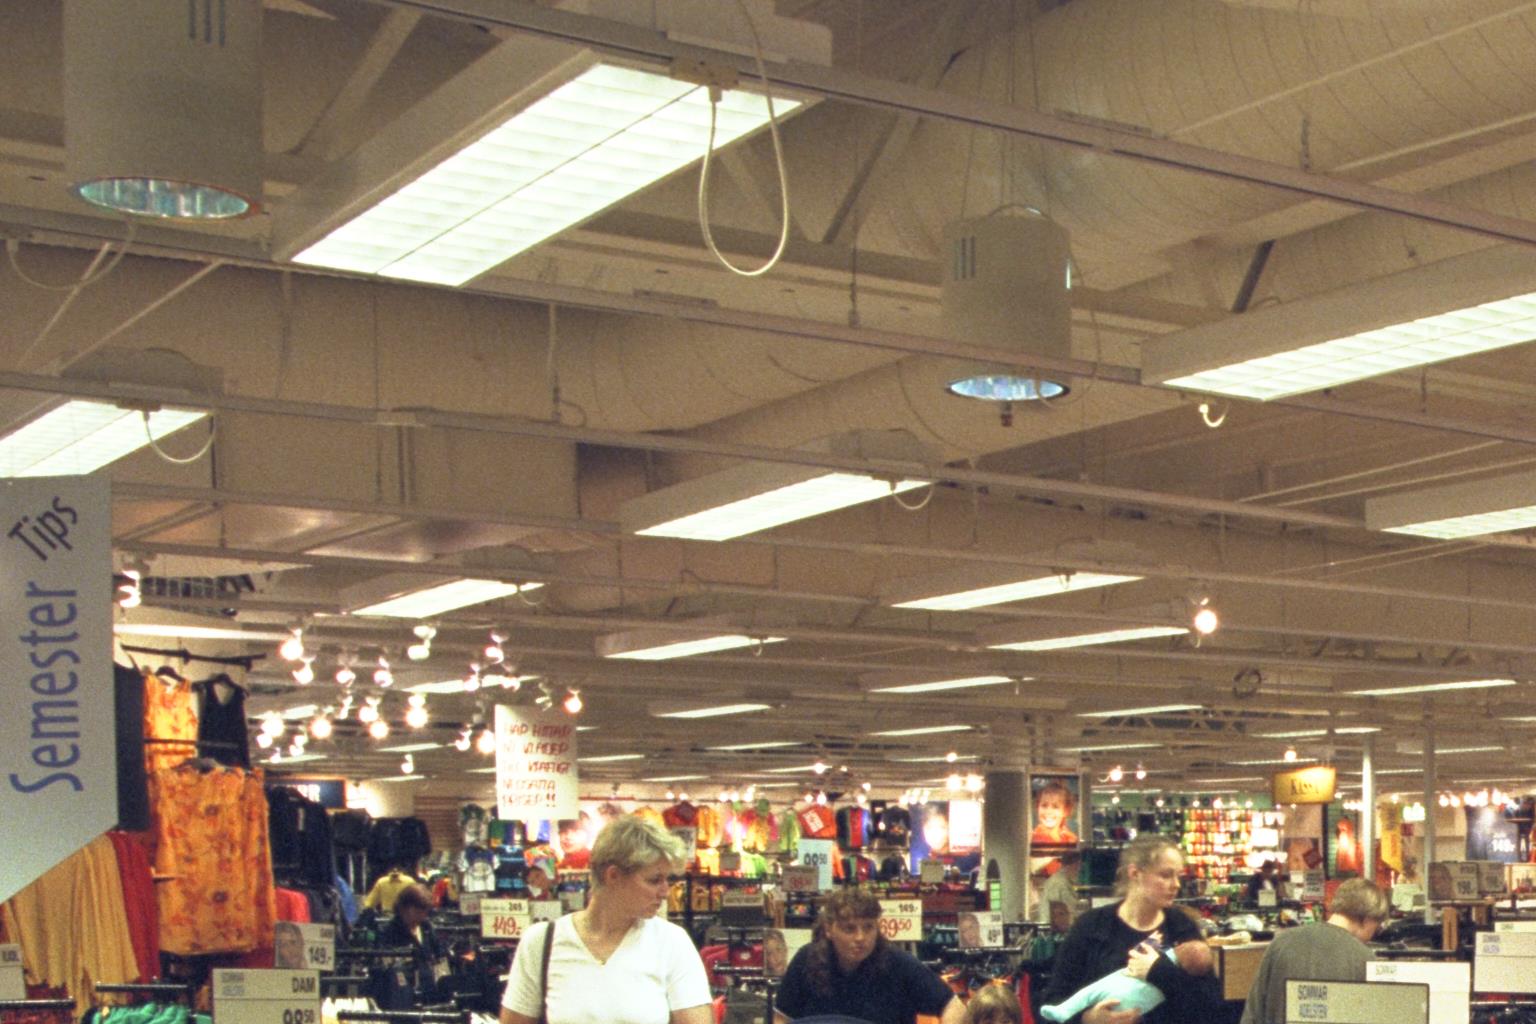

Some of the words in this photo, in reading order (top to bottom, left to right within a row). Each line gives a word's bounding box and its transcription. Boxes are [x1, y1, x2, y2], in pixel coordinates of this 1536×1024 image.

[8, 496, 77, 562] Tips
[9, 580, 83, 793] Semester
[292, 977, 316, 993] DAM
